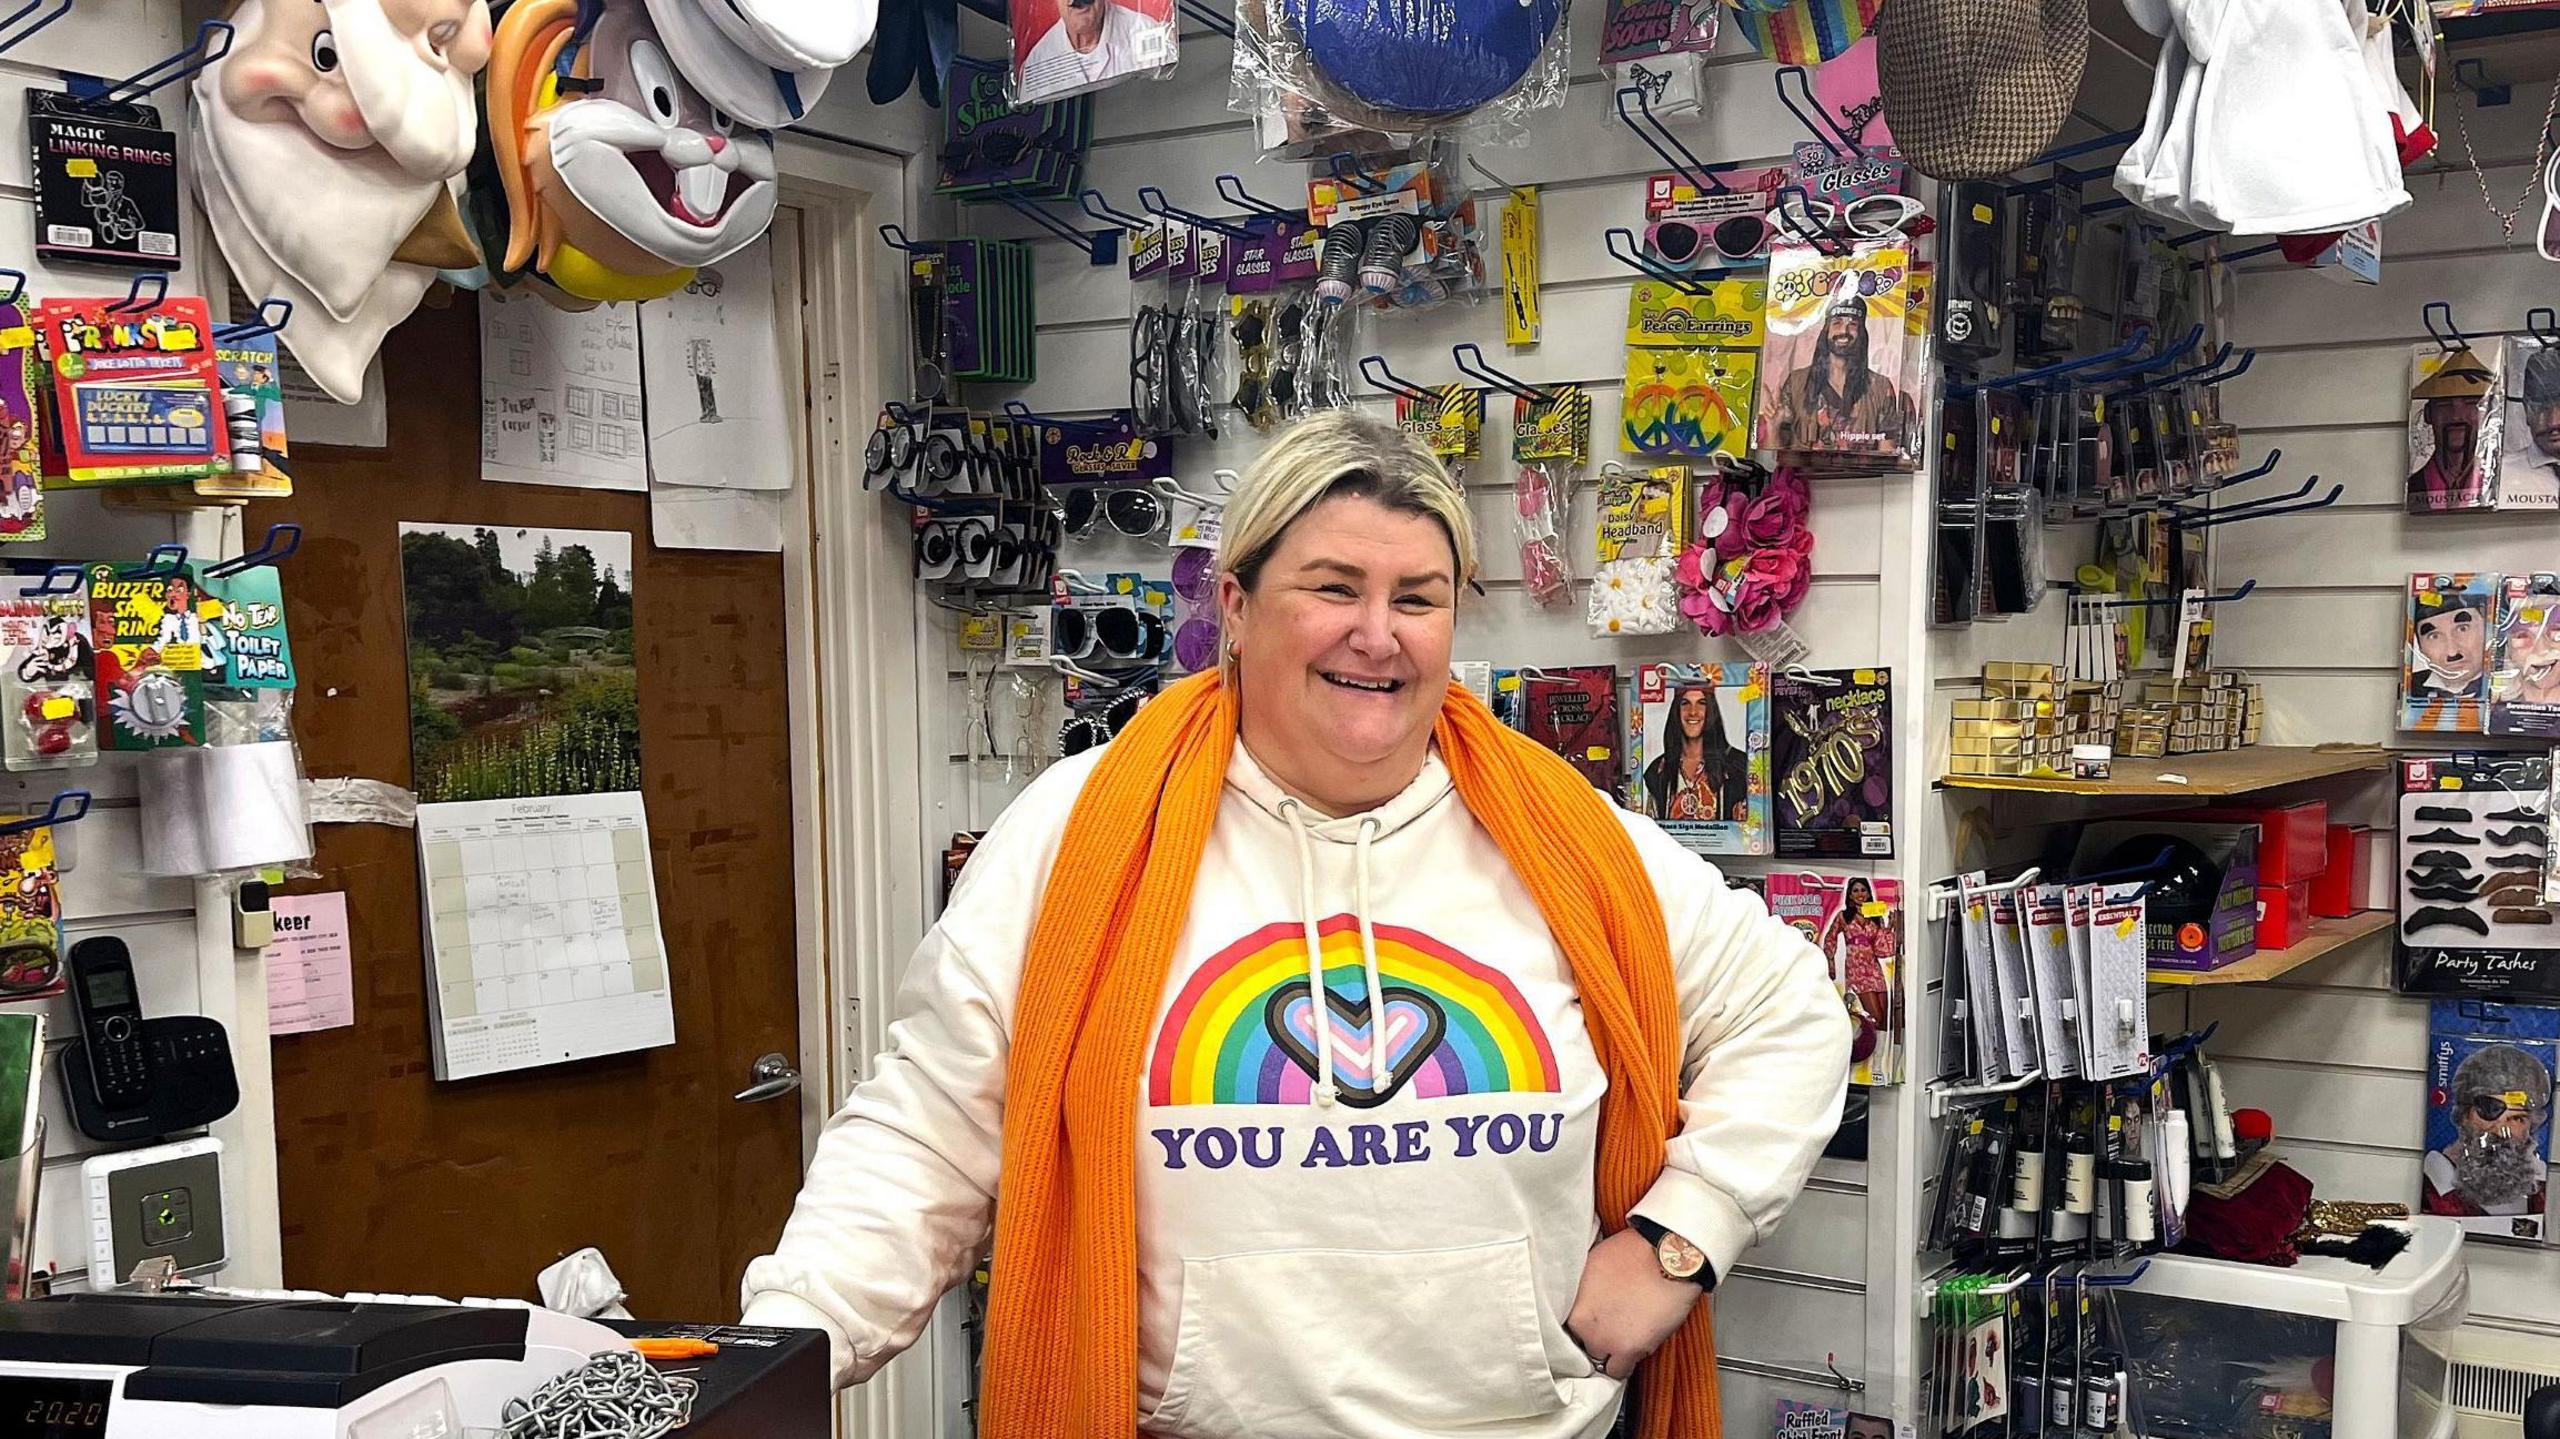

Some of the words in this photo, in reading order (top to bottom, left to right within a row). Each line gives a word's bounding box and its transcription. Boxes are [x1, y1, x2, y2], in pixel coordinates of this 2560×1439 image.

[50, 123, 107, 141] MAGIC
[49, 138, 120, 160] LINKING
[122, 147, 173, 167] RINGS
[1821, 163, 1891, 192] Glasses
[1243, 248, 1265, 262] STAR
[1235, 261, 1271, 277] GLASSES
[1642, 319, 1684, 333] Peace
[1685, 320, 1753, 335] Earrings
[215, 349, 273, 364] SCRATCH
[96, 391, 141, 402] LUCKY
[1840, 431, 1870, 442] Hippie
[1872, 431, 1887, 441] set
[1067, 443, 1100, 465] Rock
[1101, 444, 1114, 463] &
[1608, 512, 1635, 524] Daisy
[1602, 522, 1663, 539] Headband
[92, 582, 165, 599] BUZZER
[117, 620, 160, 637] RING
[226, 630, 280, 656] TOILET
[238, 655, 288, 679] PAPER
[1549, 693, 1590, 704] JEWELLED
[1825, 688, 1886, 712] necklace
[1559, 704, 1583, 713] CROSS
[511, 804, 551, 815] February
[273, 911, 311, 932] keer
[2098, 909, 2138, 922] ESSENTIALS
[2145, 923, 2174, 936] ECTOR
[2435, 951, 2479, 975] Party
[2484, 952, 2537, 972] Tashes
[2438, 1041, 2454, 1087] smiffys
[1151, 1126, 1285, 1170] YOU
[1300, 1120, 1431, 1169] ARE
[1445, 1113, 1565, 1158] YOU
[1785, 1411, 1830, 1429] Ruffled
